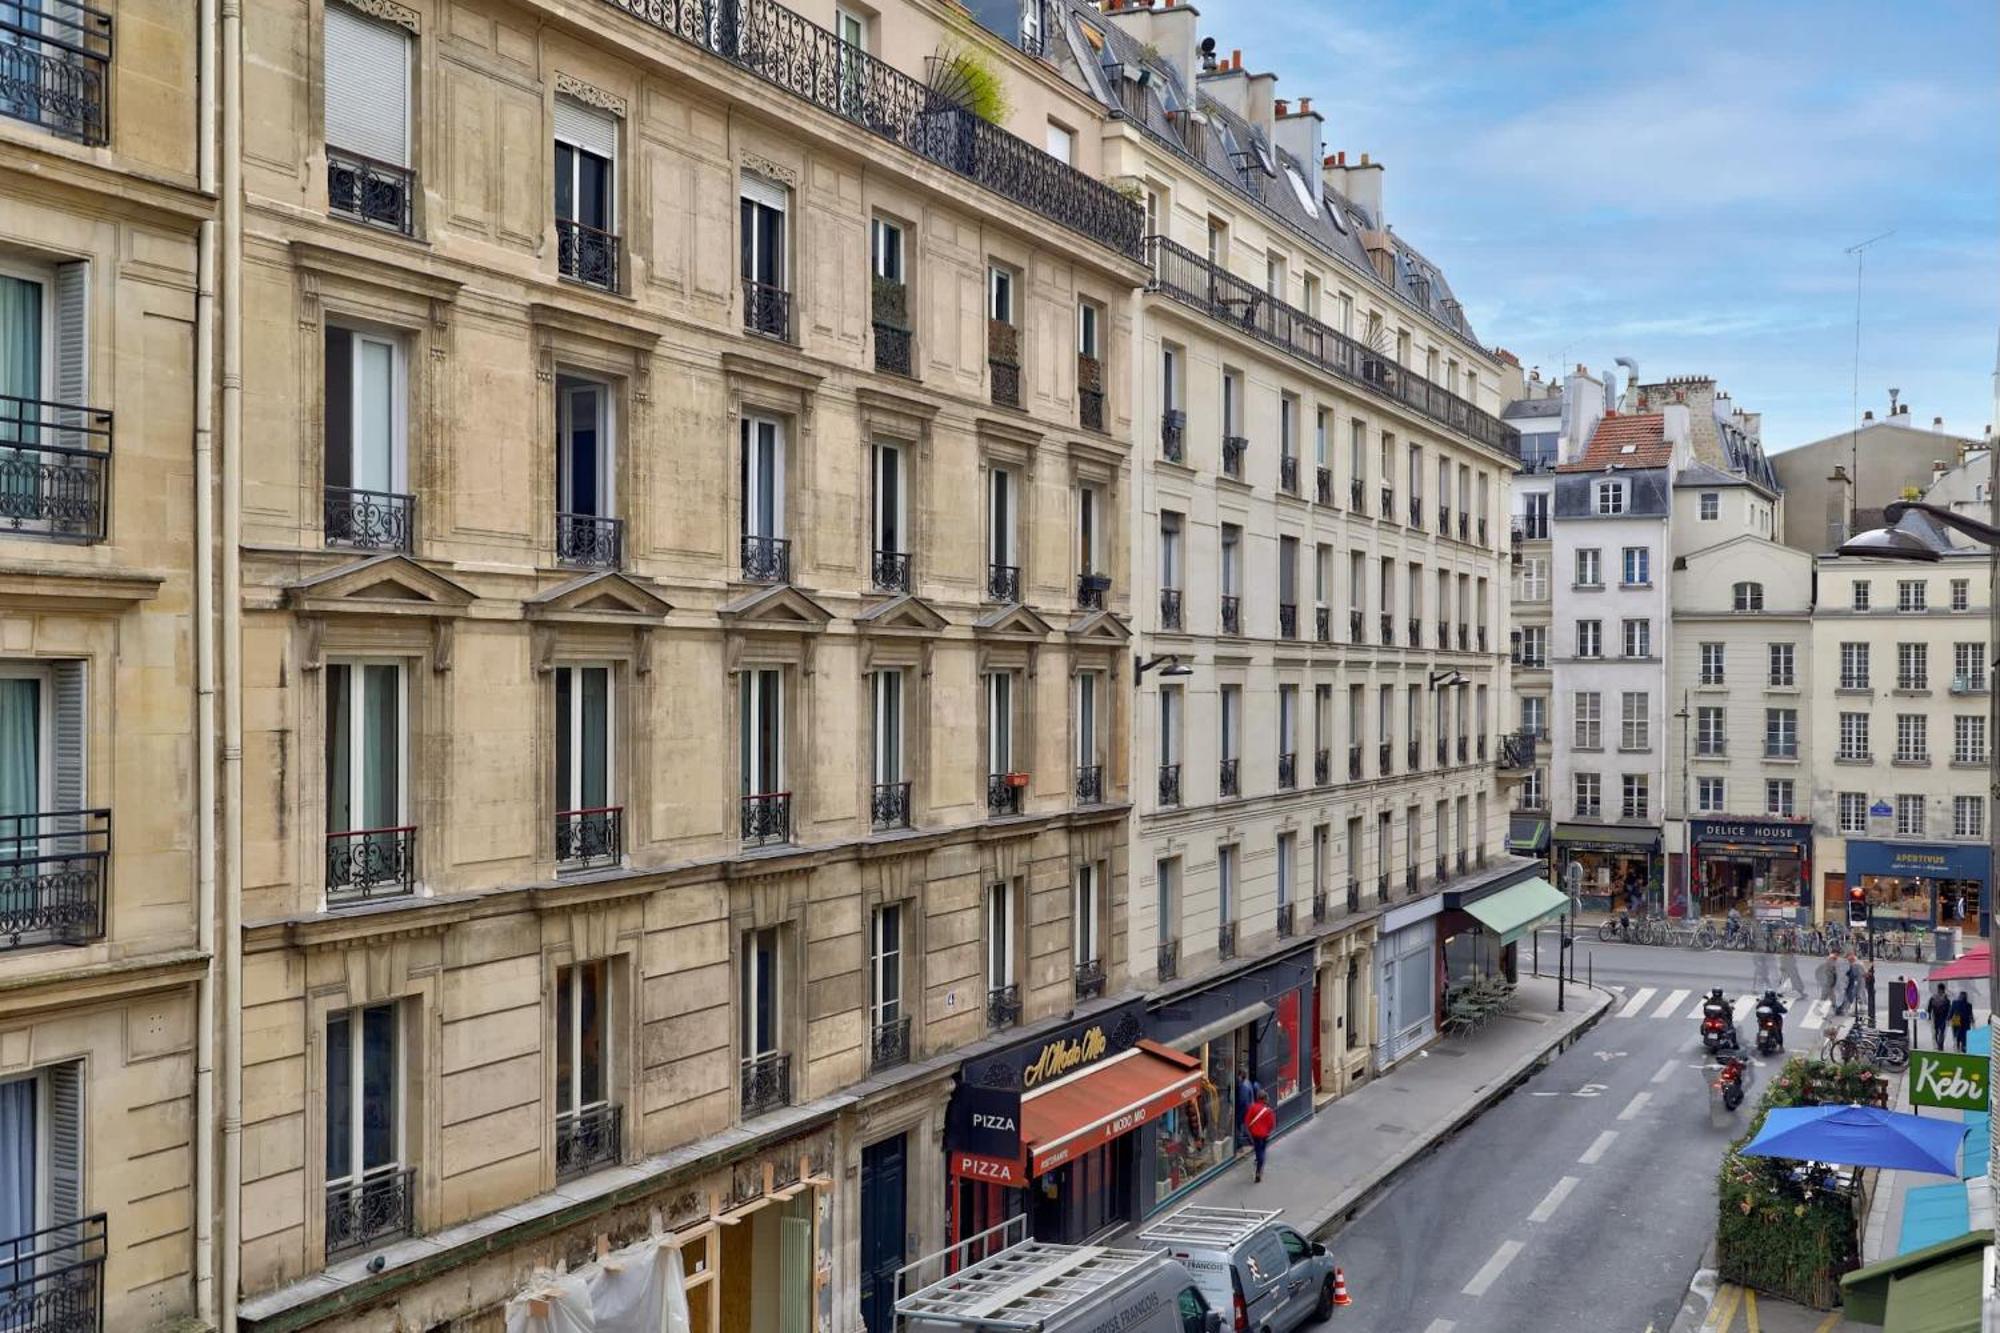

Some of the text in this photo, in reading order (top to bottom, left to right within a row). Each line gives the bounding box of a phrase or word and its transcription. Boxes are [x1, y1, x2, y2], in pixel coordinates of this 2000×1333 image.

[1705, 825, 1793, 838] DELICE HOUSE
[972, 1113, 1015, 1132] PIZZA
[1113, 1113, 1132, 1134] MODO
[1134, 1108, 1146, 1122] MIO
[961, 1158, 1012, 1181] PIZZA
